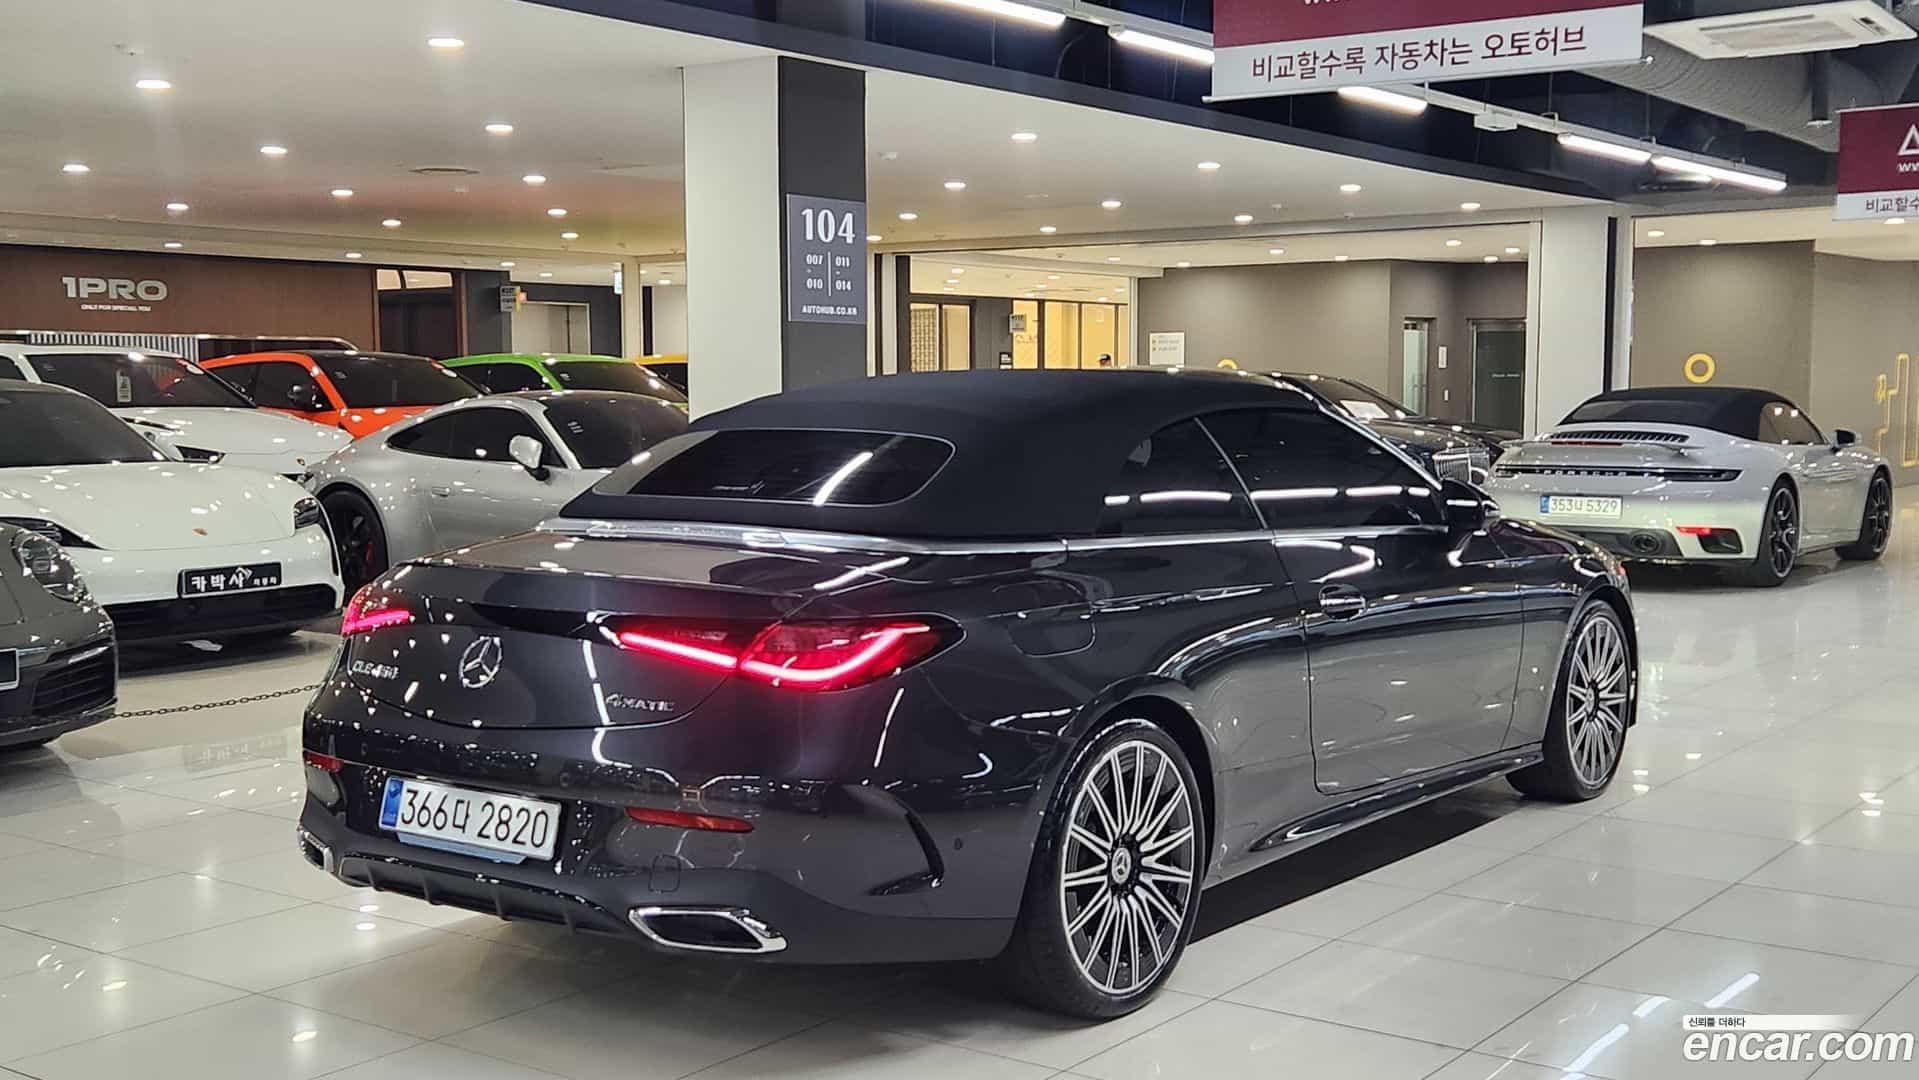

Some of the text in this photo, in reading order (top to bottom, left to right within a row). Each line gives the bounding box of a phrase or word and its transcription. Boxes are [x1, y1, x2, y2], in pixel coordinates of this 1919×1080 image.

[1252, 26, 1587, 82] 비교할수록 자동차는 오토허브
[801, 208, 855, 244] 104
[806, 254, 823, 265] 007
[835, 255, 850, 267] 011
[62, 276, 168, 301] 1PRO
[806, 278, 823, 289] 010
[835, 280, 851, 291] 014
[191, 571, 245, 592] 카박사
[606, 694, 675, 711] 4MATIC
[401, 788, 549, 848] 366다 2820
